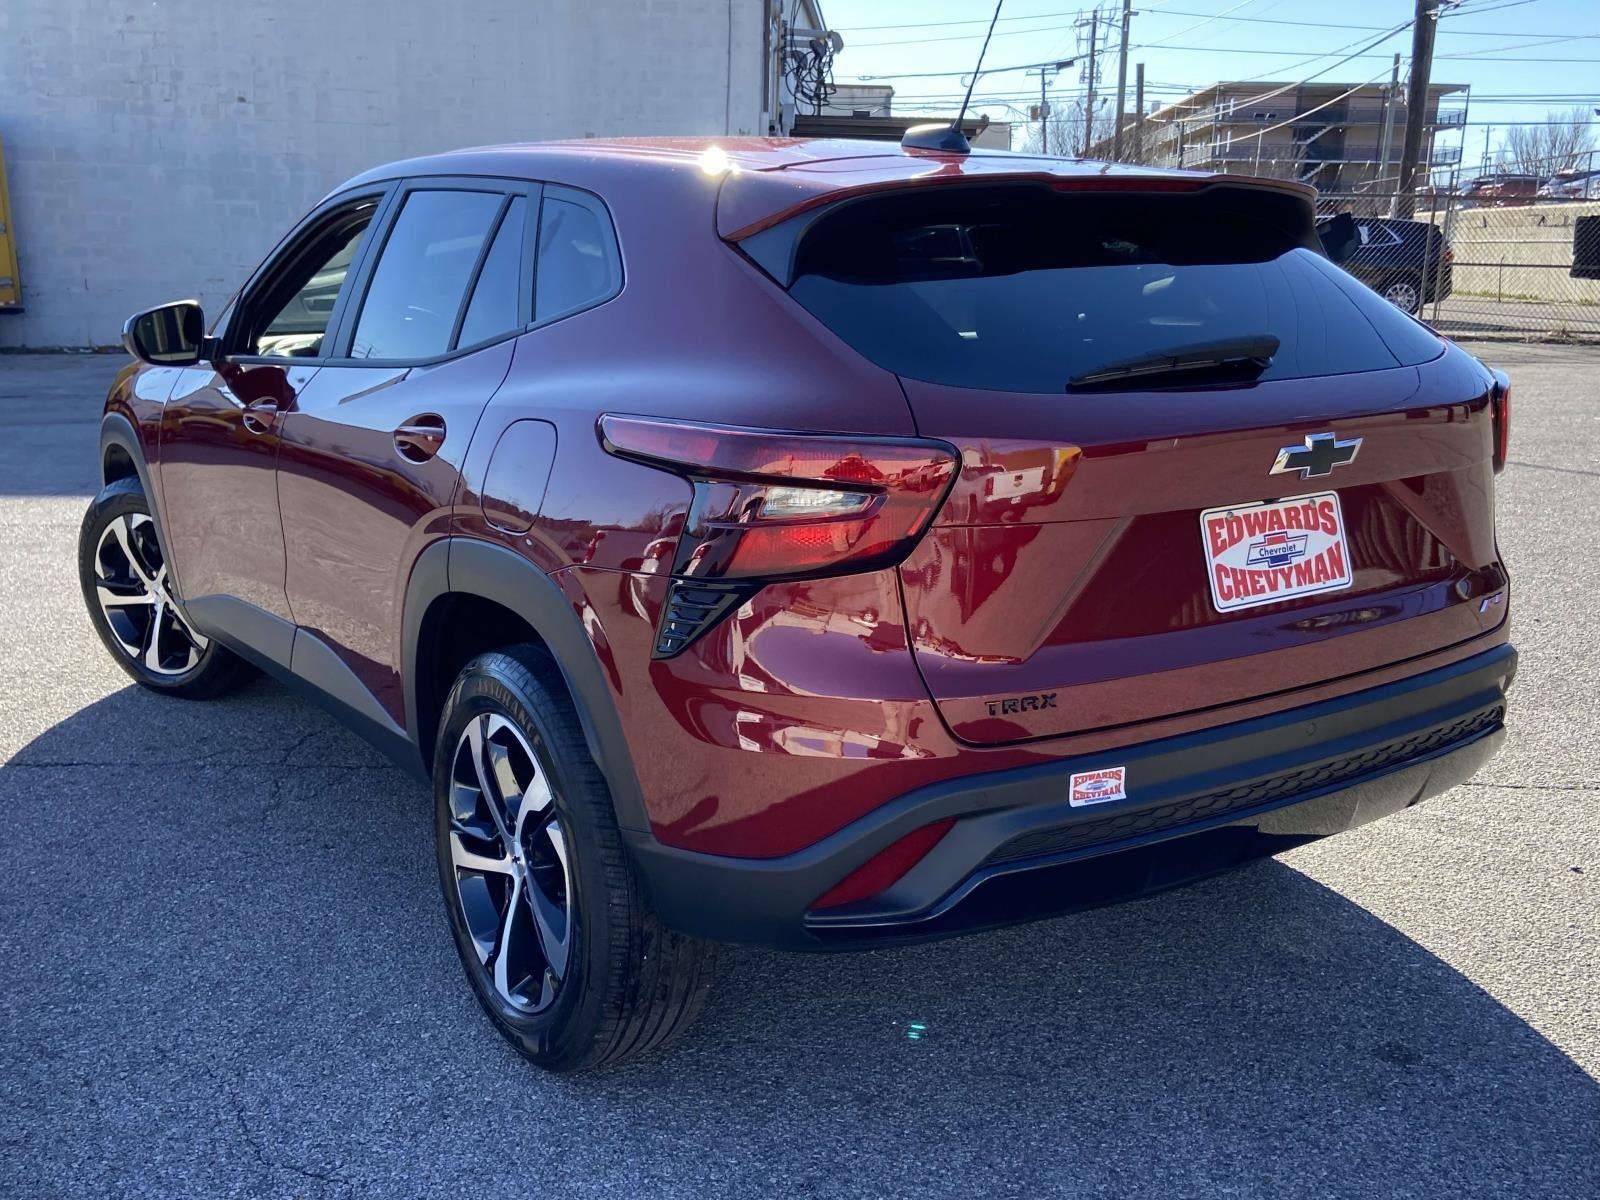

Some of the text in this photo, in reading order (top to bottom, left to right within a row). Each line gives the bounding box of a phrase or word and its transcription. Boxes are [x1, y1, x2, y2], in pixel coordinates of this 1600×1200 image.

[1207, 500, 1338, 559] EDWARDS
[1259, 543, 1297, 557] Chevrolet
[1214, 540, 1346, 602] CHEVYMAN
[984, 693, 1057, 716] TRAX
[1073, 769, 1122, 788] EDWARDS
